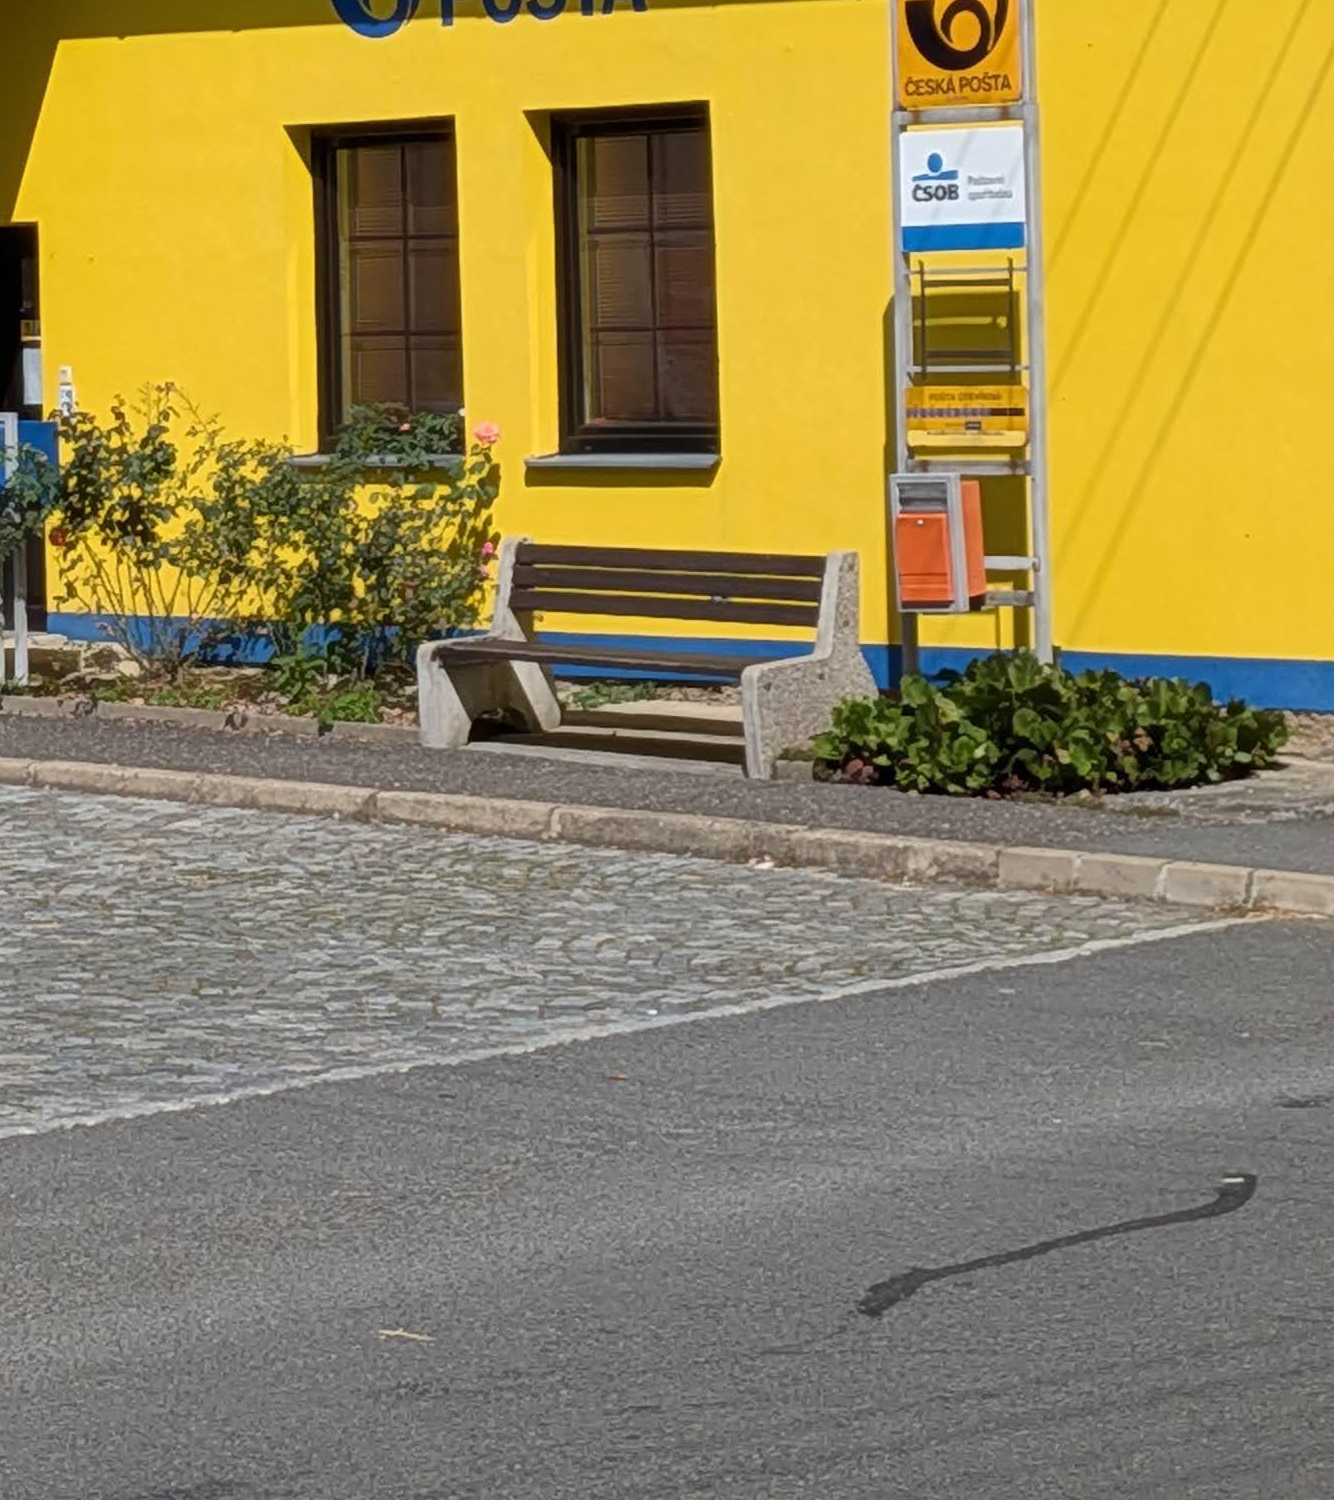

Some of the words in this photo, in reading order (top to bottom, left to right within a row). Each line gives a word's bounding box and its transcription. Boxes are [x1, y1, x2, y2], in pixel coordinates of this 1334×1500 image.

[905, 75, 956, 97] ČESKÁ
[959, 71, 1012, 93] POŠTA
[912, 183, 959, 202] ČSOB
